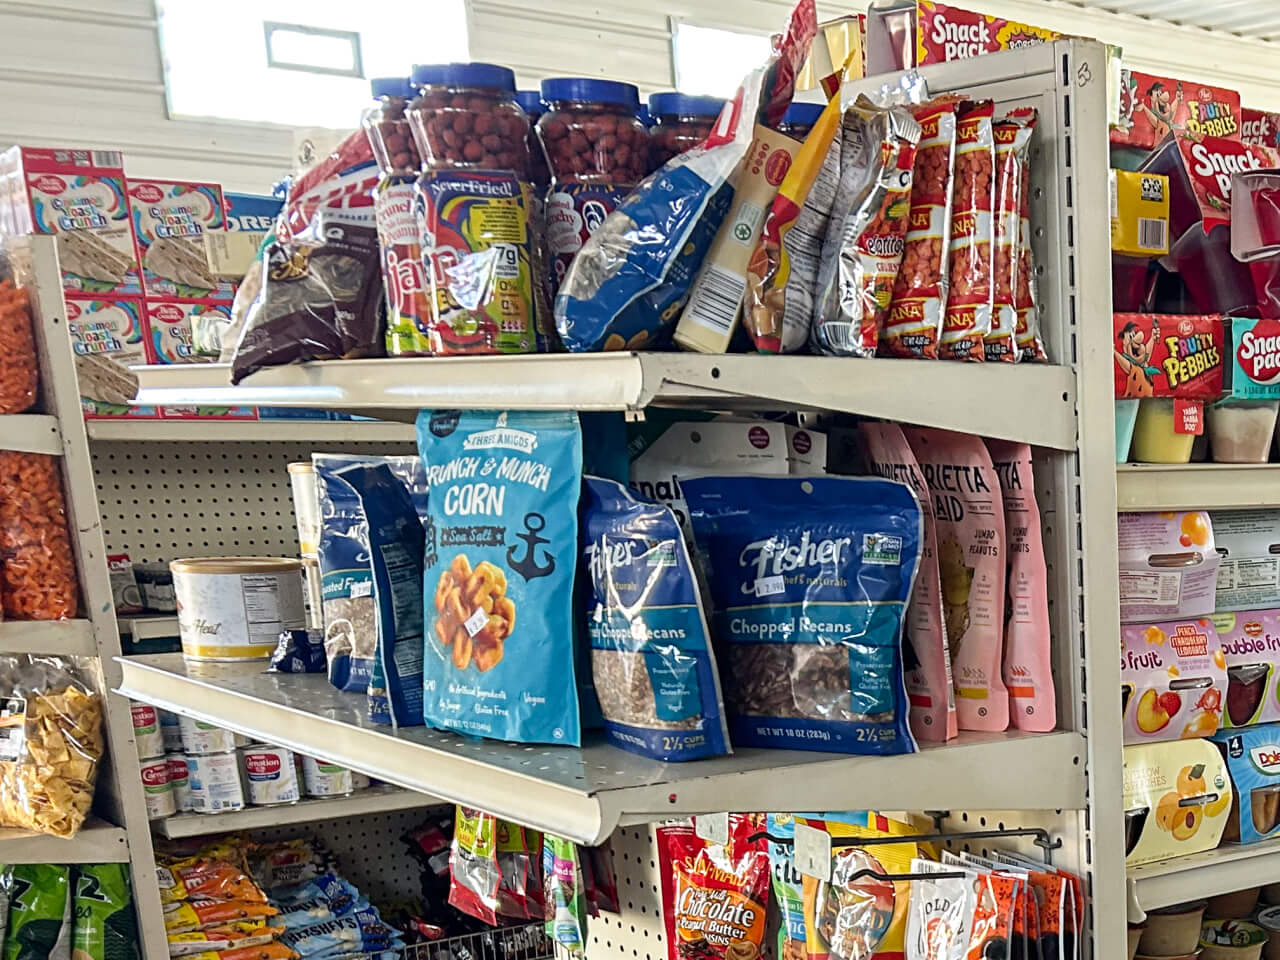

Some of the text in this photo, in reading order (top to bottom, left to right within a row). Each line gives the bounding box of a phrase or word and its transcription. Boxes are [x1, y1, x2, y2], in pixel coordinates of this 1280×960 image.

[932, 14, 990, 45] Snack
[1187, 100, 1231, 120] FRUITY
[1186, 116, 1237, 137] PEBBLES
[1191, 143, 1261, 175] Snack
[64, 206, 97, 217] Toast
[59, 215, 107, 230] Crunch
[161, 215, 193, 226] Toast
[156, 223, 202, 238] Crunch
[77, 329, 111, 341] Toast
[73, 339, 122, 355] Crunch
[1165, 333, 1213, 357] FRUITY
[1162, 347, 1220, 388] PEBBLES
[498, 435, 529, 448] AMIGOS
[499, 456, 552, 491] MUNCH
[443, 483, 505, 516] CORN
[449, 530, 493, 542] Sea Salt
[973, 527, 995, 542] JUMBO
[968, 542, 998, 557] PEANUTS
[740, 530, 850, 595] Fisher
[731, 618, 795, 634] Chopped
[1128, 651, 1163, 670] fruit
[1231, 737, 1240, 749] 4
[678, 886, 756, 928] Chocolate
[708, 920, 746, 940] Butter
